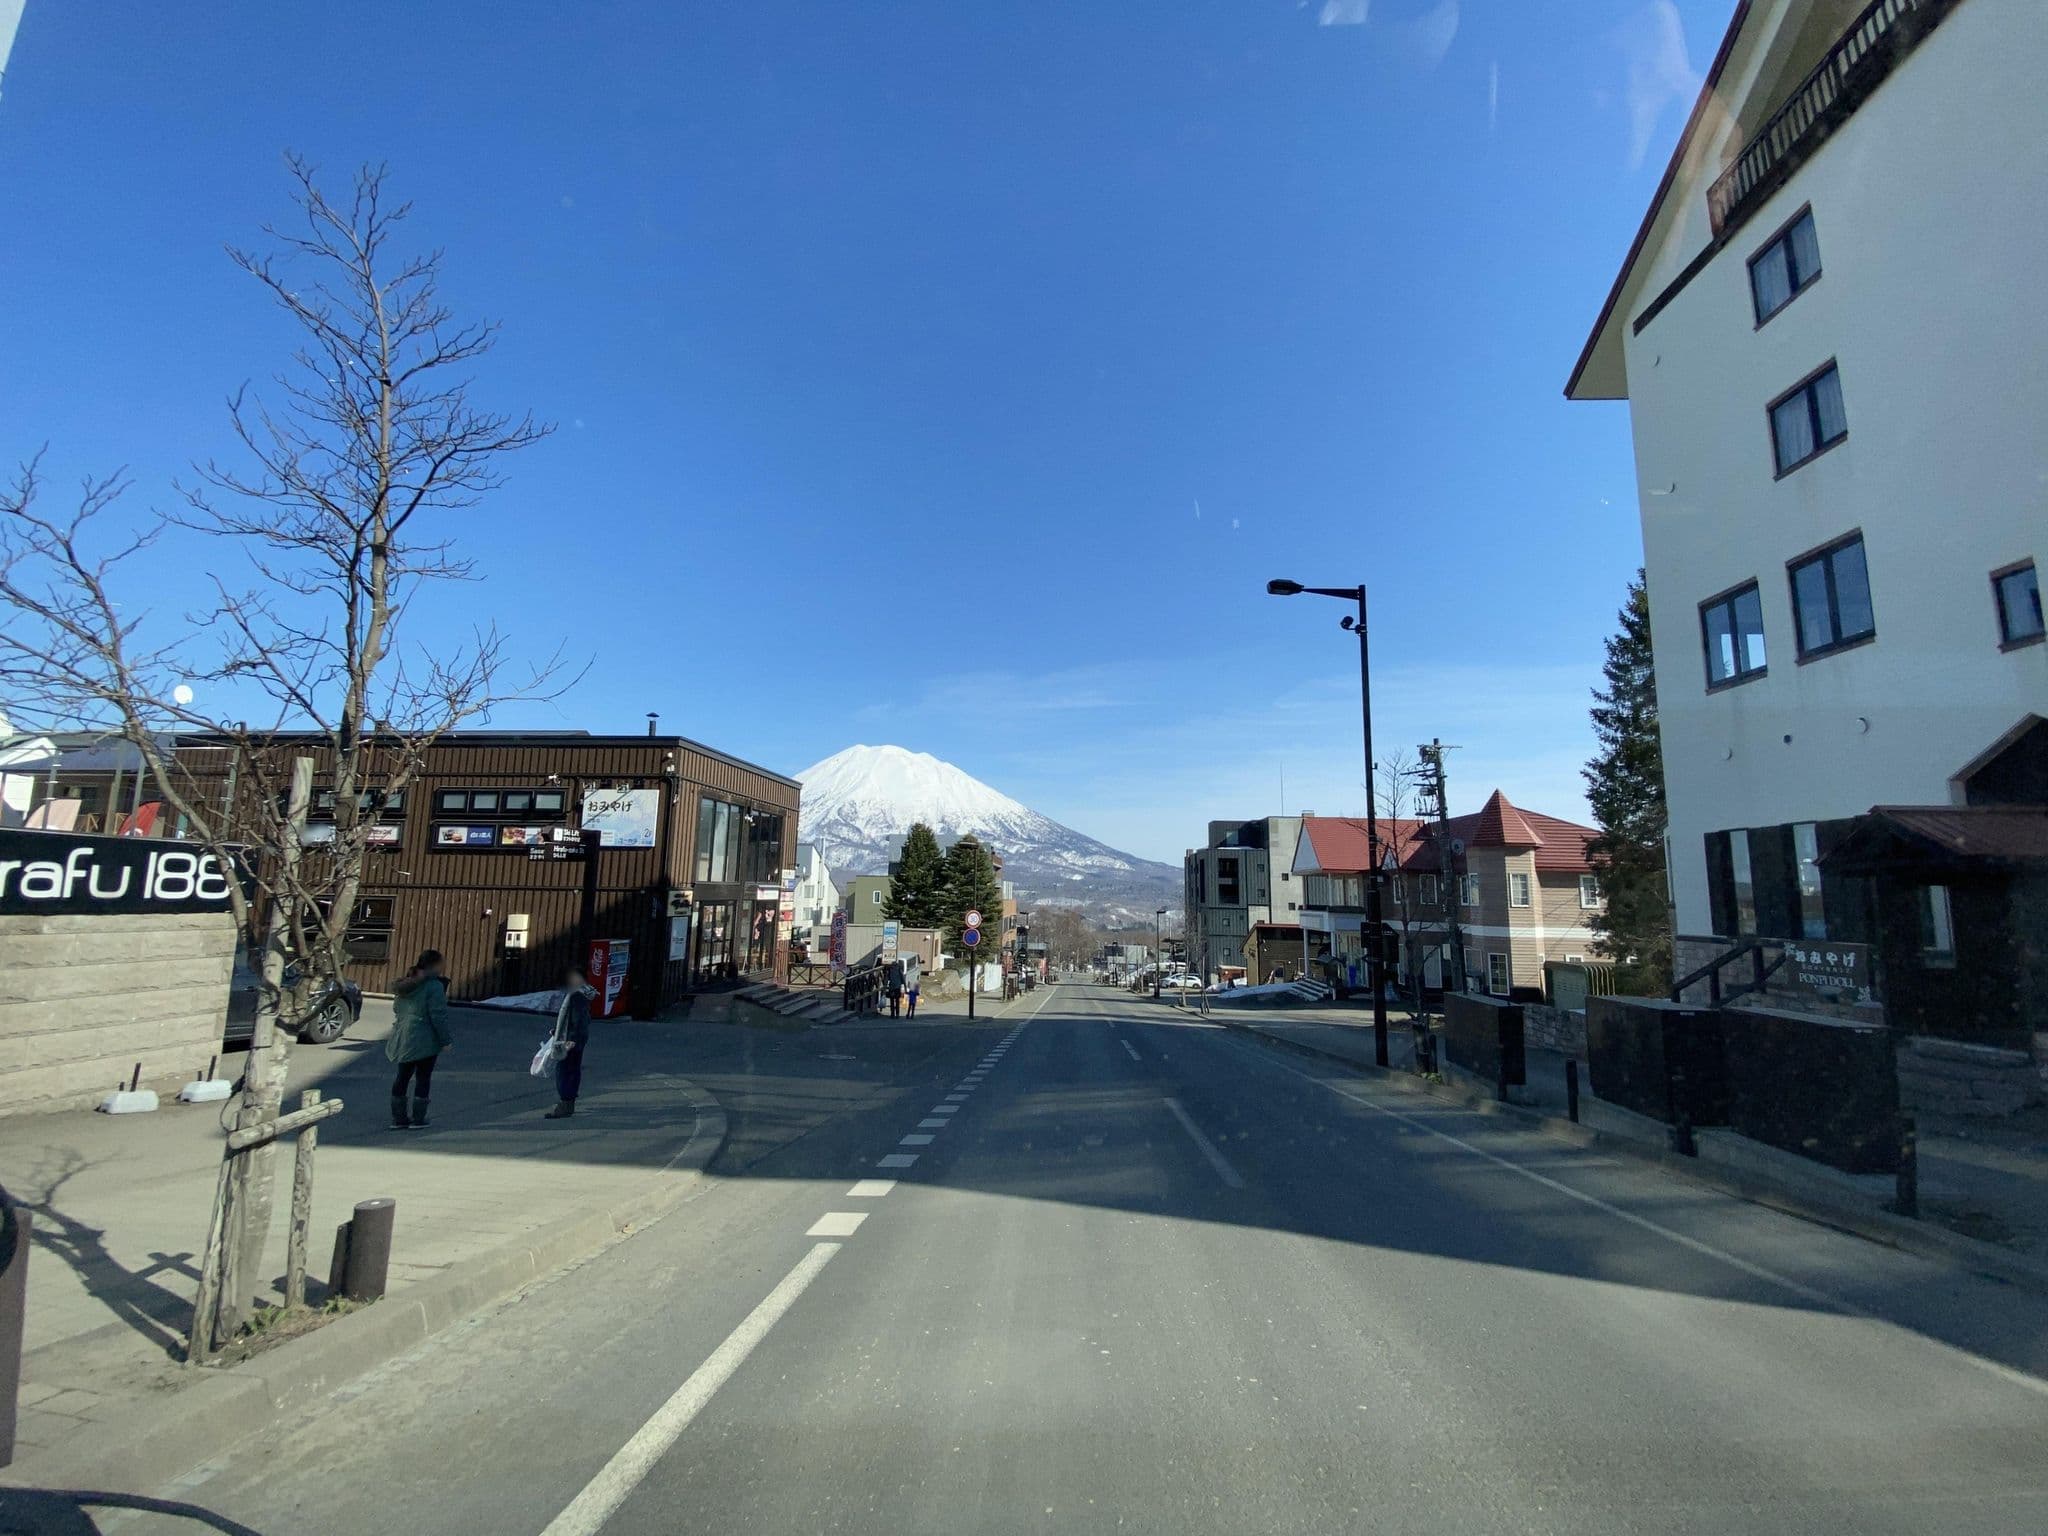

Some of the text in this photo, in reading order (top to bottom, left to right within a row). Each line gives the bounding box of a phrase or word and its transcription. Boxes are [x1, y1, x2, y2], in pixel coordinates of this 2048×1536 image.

[587, 800, 633, 812] おみやげ
[0, 847, 132, 899] rafu
